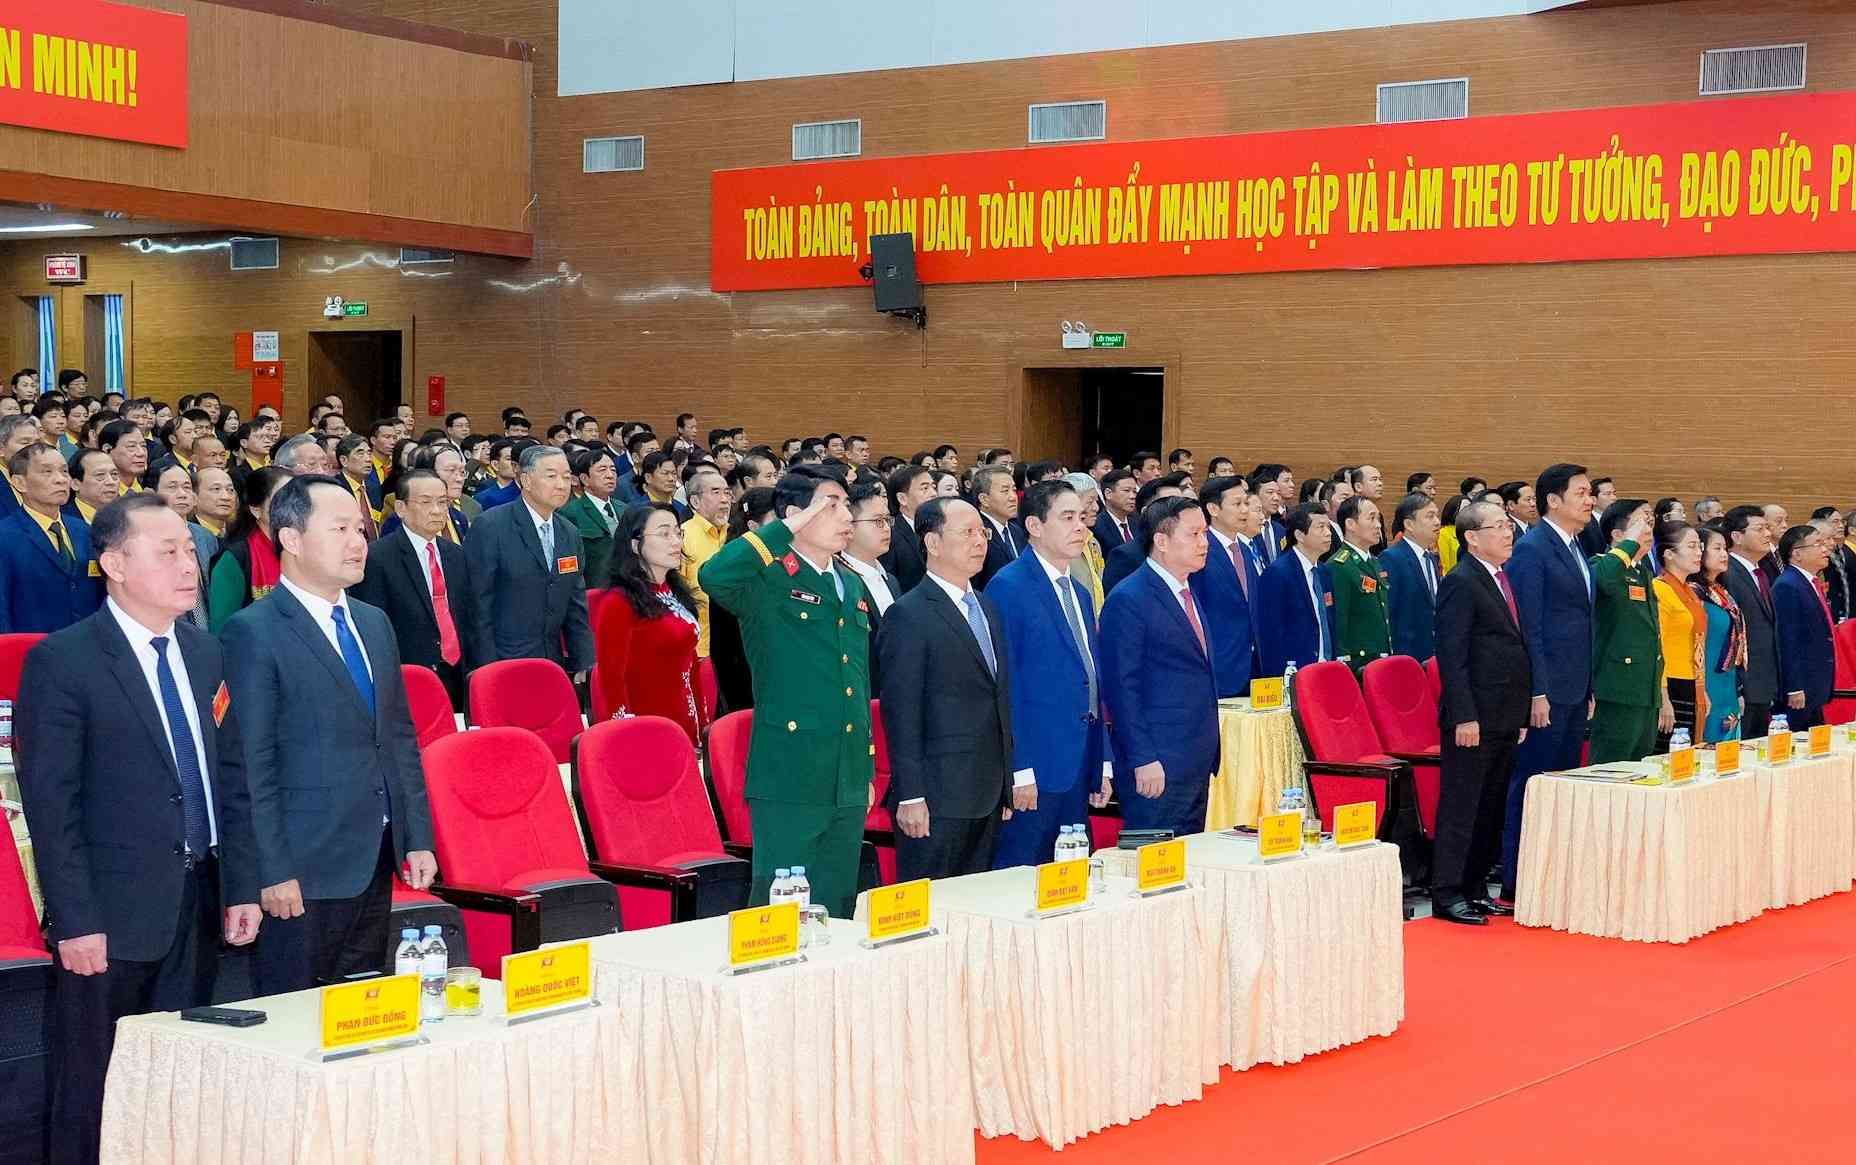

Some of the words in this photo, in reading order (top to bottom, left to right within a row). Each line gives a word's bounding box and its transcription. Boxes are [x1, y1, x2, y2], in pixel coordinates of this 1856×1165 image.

[33, 33, 137, 107] MINH!
[744, 195, 793, 260] TOÀN
[799, 186, 858, 262] ĐẢNG,
[864, 187, 917, 255] TOÀN
[923, 184, 972, 257] DÂN,
[979, 181, 1034, 250] TOÀN
[1041, 176, 1101, 253] QUÂN
[1107, 162, 1152, 244] ĐẨY
[1159, 181, 1229, 255] MẠNH
[1237, 177, 1286, 252] HỌC
[1293, 162, 1340, 250] TẬP
[1348, 158, 1379, 234] VÀ
[1387, 156, 1443, 232] LÀM
[1451, 163, 1518, 229] THEO
[1527, 154, 1564, 226] TƯ
[1569, 135, 1670, 228] TƯỞNG,
[1680, 150, 1741, 233] ĐẠO
[1749, 133, 1819, 222] ĐỨC,
